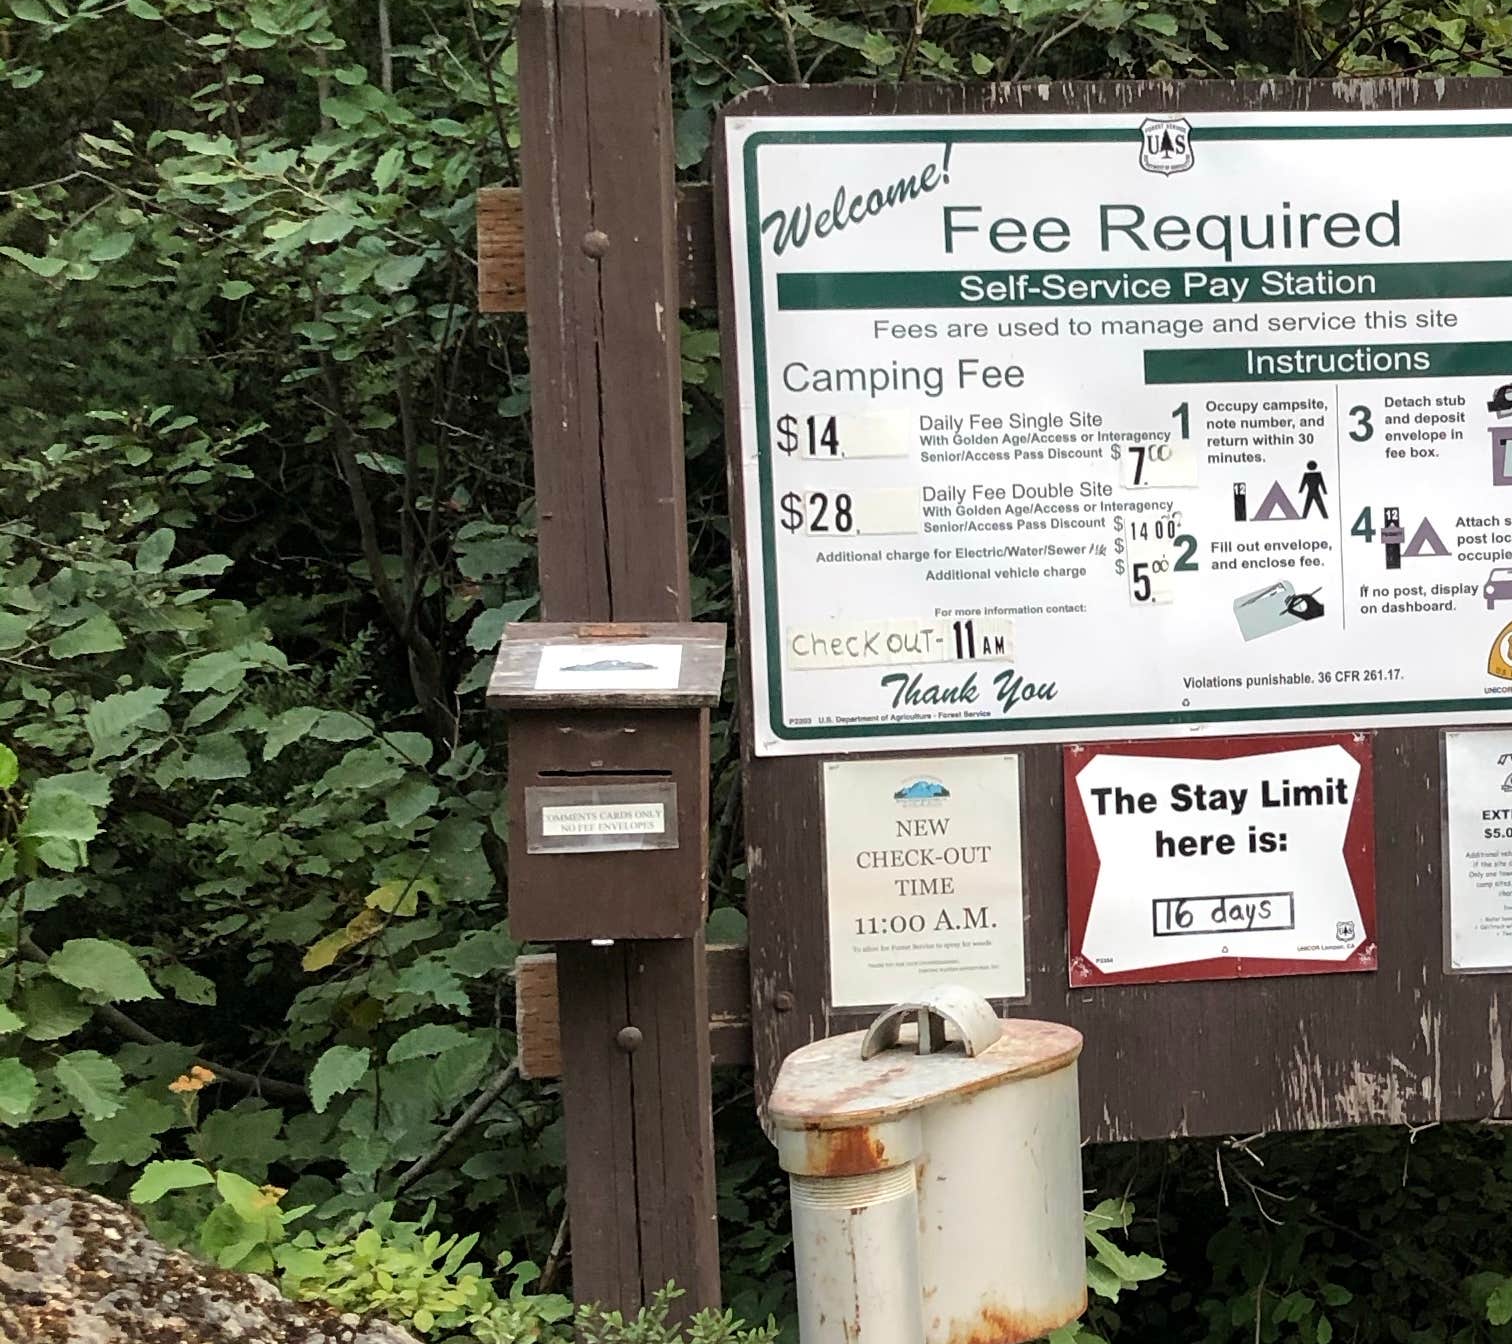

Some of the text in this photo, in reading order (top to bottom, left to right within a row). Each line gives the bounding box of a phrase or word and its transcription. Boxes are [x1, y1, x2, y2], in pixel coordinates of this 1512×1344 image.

[761, 143, 953, 257] Welcome!
[942, 199, 1401, 262] Fee Required
[959, 269, 1377, 303] Self-Service Pay Station
[874, 309, 1458, 339] Fees are used to manage and service this site
[1247, 349, 1430, 375] Instructions
[783, 359, 1025, 398] Camping Fee
[920, 413, 1103, 433] Daily Fee Single Site
[1172, 399, 1328, 440] 1 Occupy campsite,
[1206, 415, 1324, 430] note number, and
[1349, 394, 1465, 442] 3 Detach stub
[1385, 412, 1465, 426] and deposit
[920, 429, 1171, 446] With Golden Age/Access or Interagency
[1207, 432, 1314, 446] return within 30
[1385, 429, 1463, 444] envelope in
[1207, 451, 1265, 464] minutes.
[1385, 446, 1439, 459] fee box.
[923, 483, 1113, 505] Daily Fee Double Site
[1173, 534, 1332, 571] 2 Fill out envelope,
[1212, 556, 1325, 569] and enclose fee.
[881, 669, 1058, 713] Thank You
[1091, 778, 1348, 816] The Stay Limit
[896, 818, 950, 837] NEW
[1156, 826, 1287, 858] here is:
[856, 846, 991, 869] CHECK-OUT
[895, 877, 954, 897] TIME
[855, 907, 997, 935] 11:00 A.M.
[1165, 897, 1272, 930] 16 days
